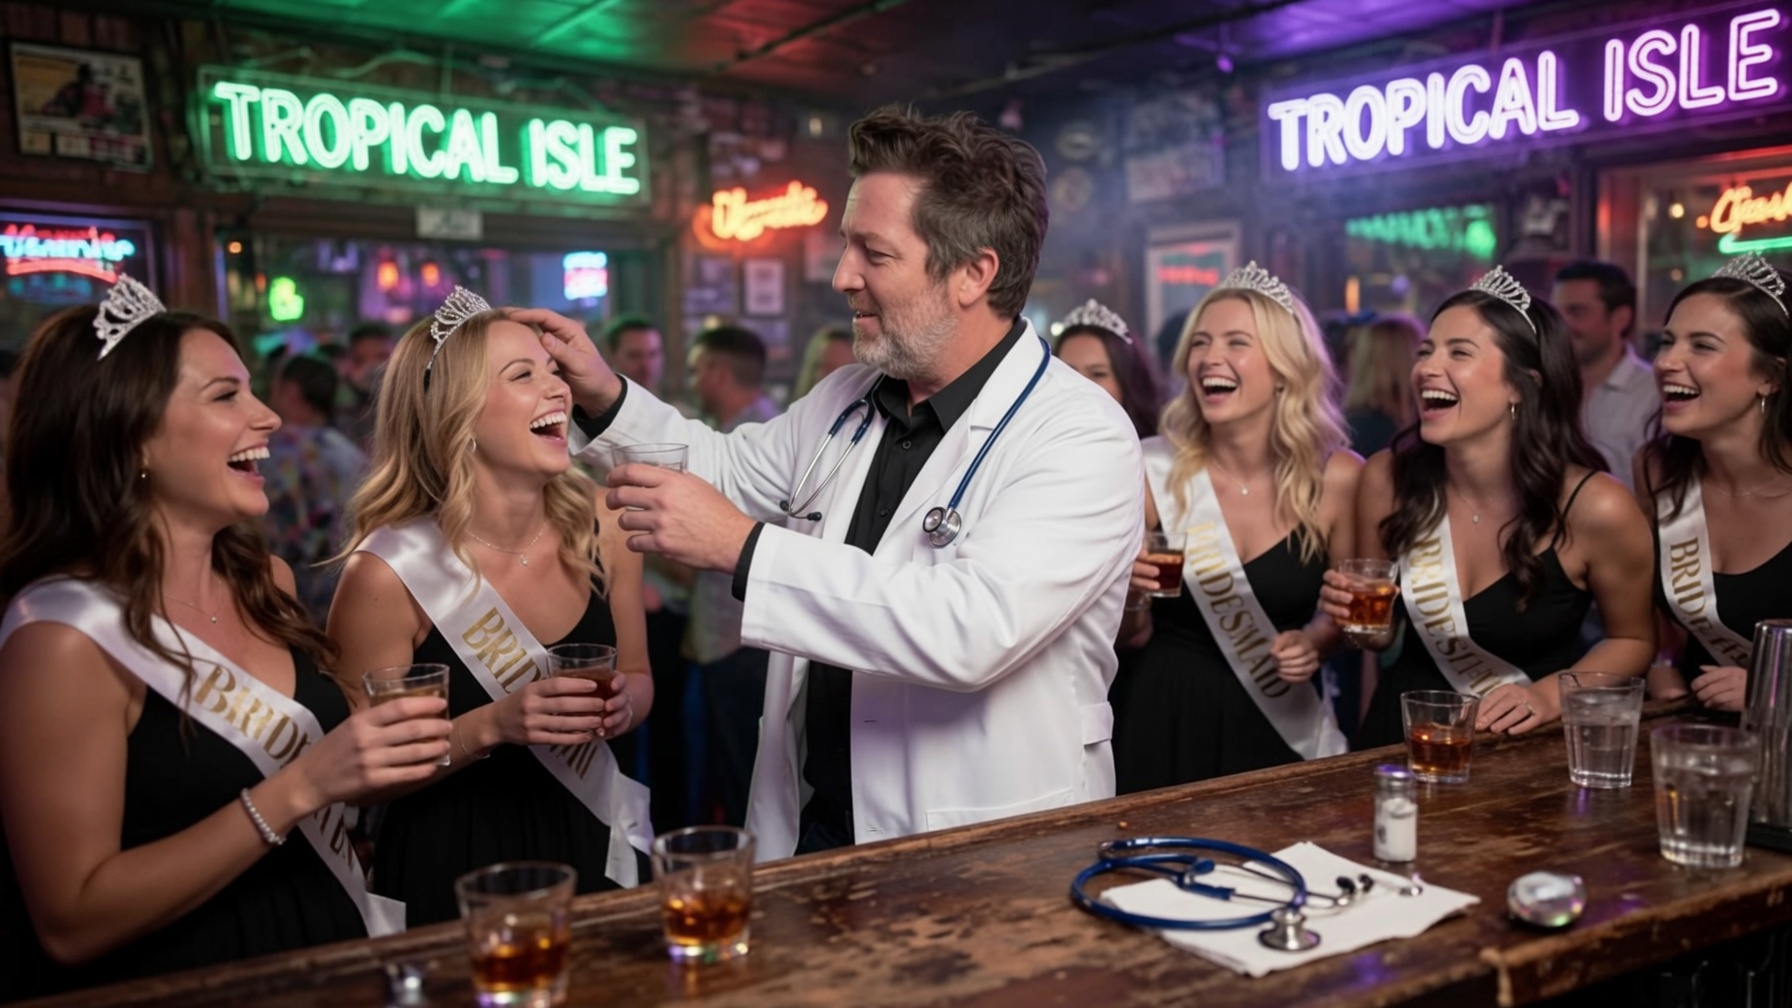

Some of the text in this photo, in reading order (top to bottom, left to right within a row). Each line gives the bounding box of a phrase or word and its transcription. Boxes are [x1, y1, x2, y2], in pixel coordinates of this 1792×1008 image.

[214, 81, 640, 195] TROPICAL ISLE
[1268, 8, 1780, 171] TROPICAL ISLE
